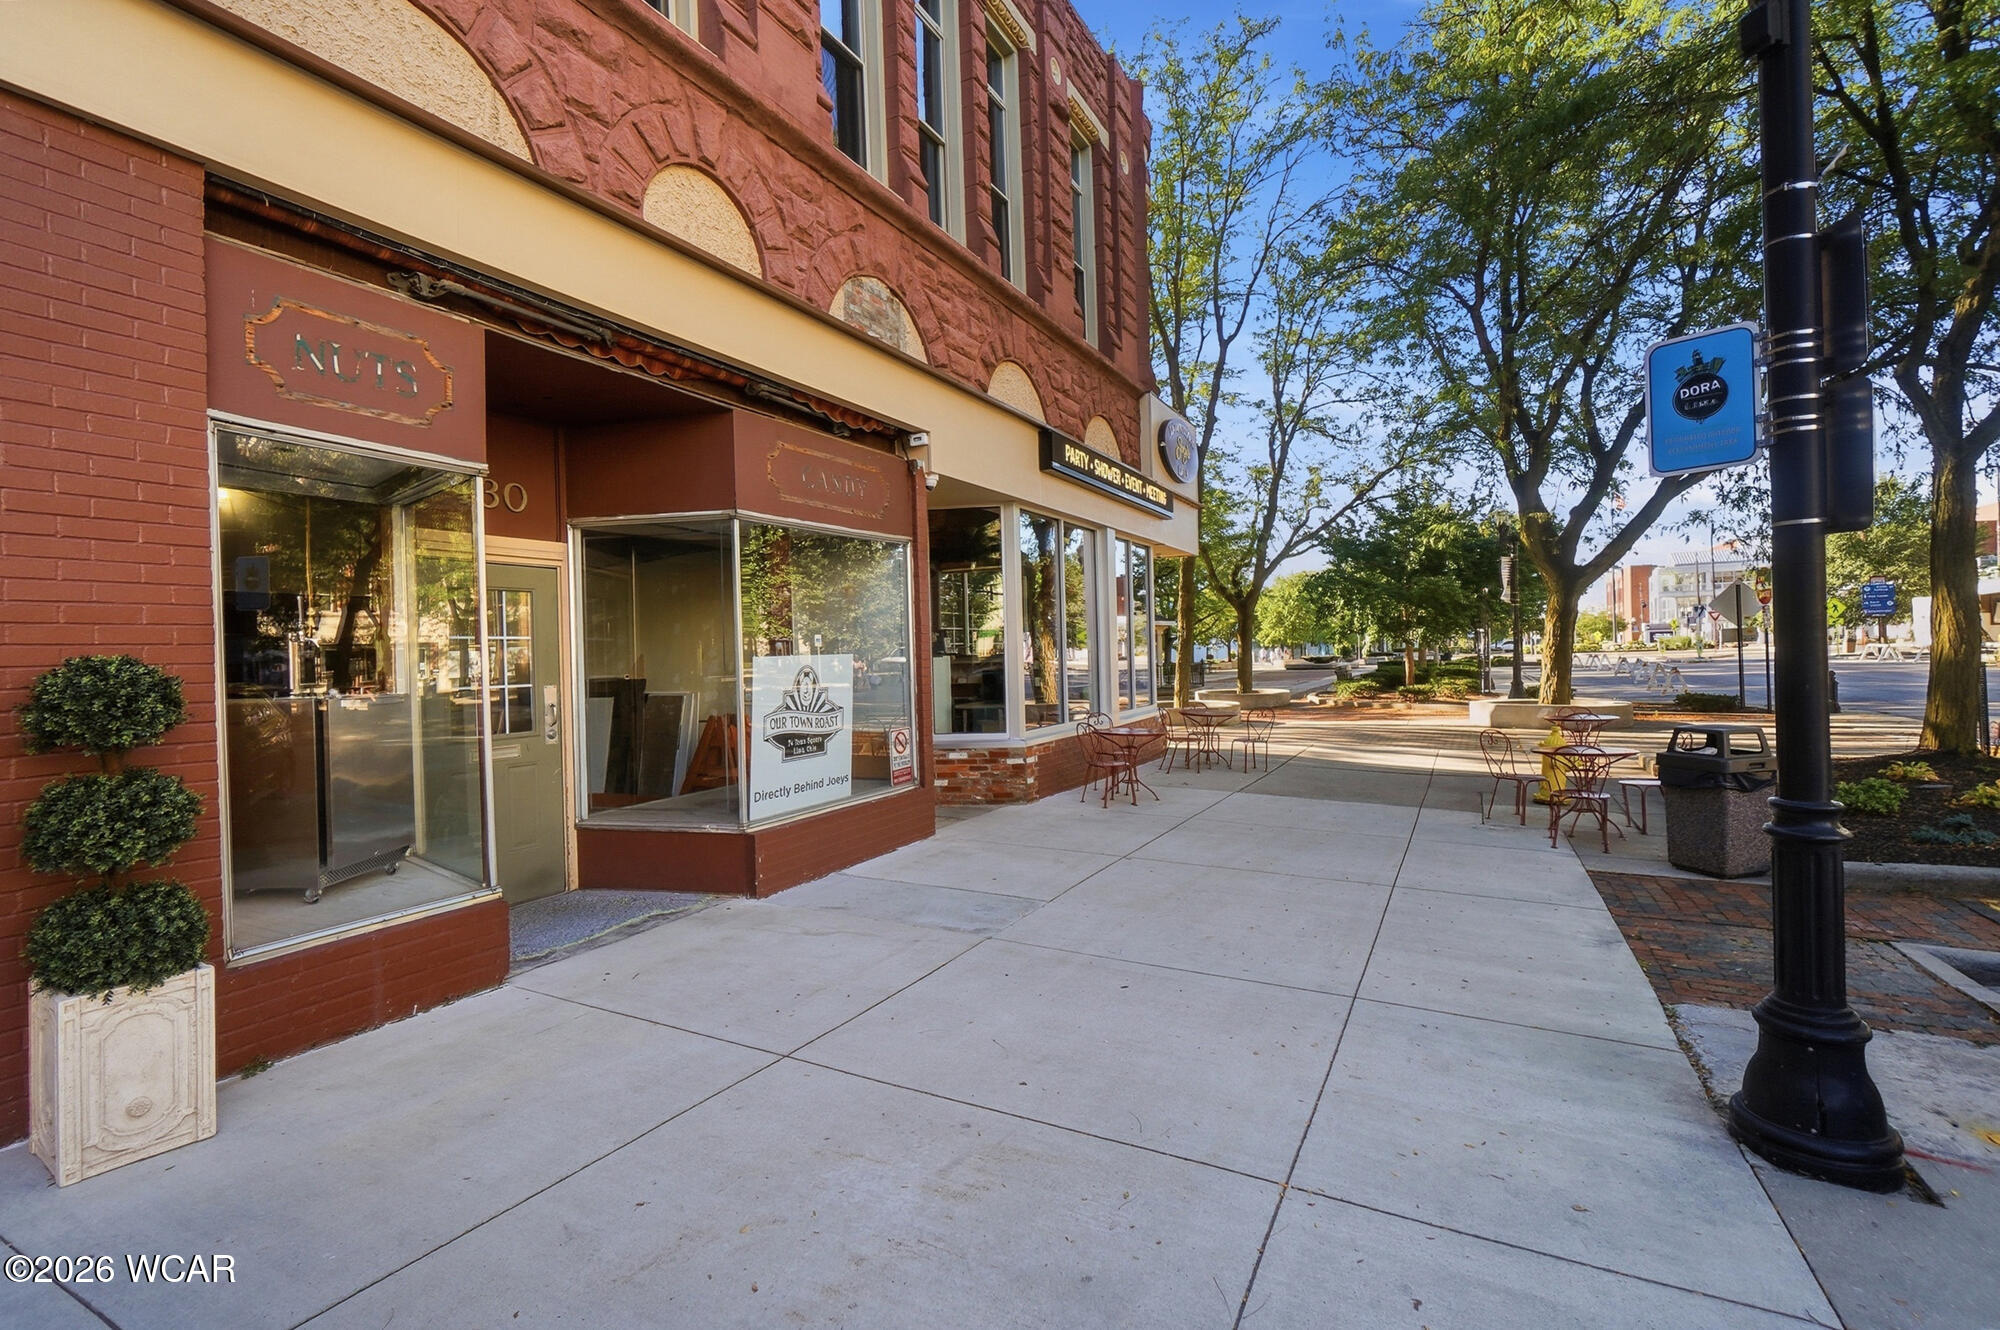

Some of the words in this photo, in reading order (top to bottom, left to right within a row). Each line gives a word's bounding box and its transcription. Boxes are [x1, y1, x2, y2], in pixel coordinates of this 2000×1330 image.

[291, 333, 418, 398] NUTS
[1680, 379, 1721, 399] DORA
[1065, 443, 1090, 470] PARTY
[1094, 458, 1122, 486] SHOWER
[1124, 472, 1144, 494] EVENT
[1145, 483, 1167, 506] MEETING
[769, 716, 787, 730] OUR
[790, 715, 813, 729] TOWN
[815, 714, 839, 729] ROAST
[754, 786, 791, 803] Directly
[794, 777, 824, 794] Behind
[826, 773, 849, 787] Joeys
